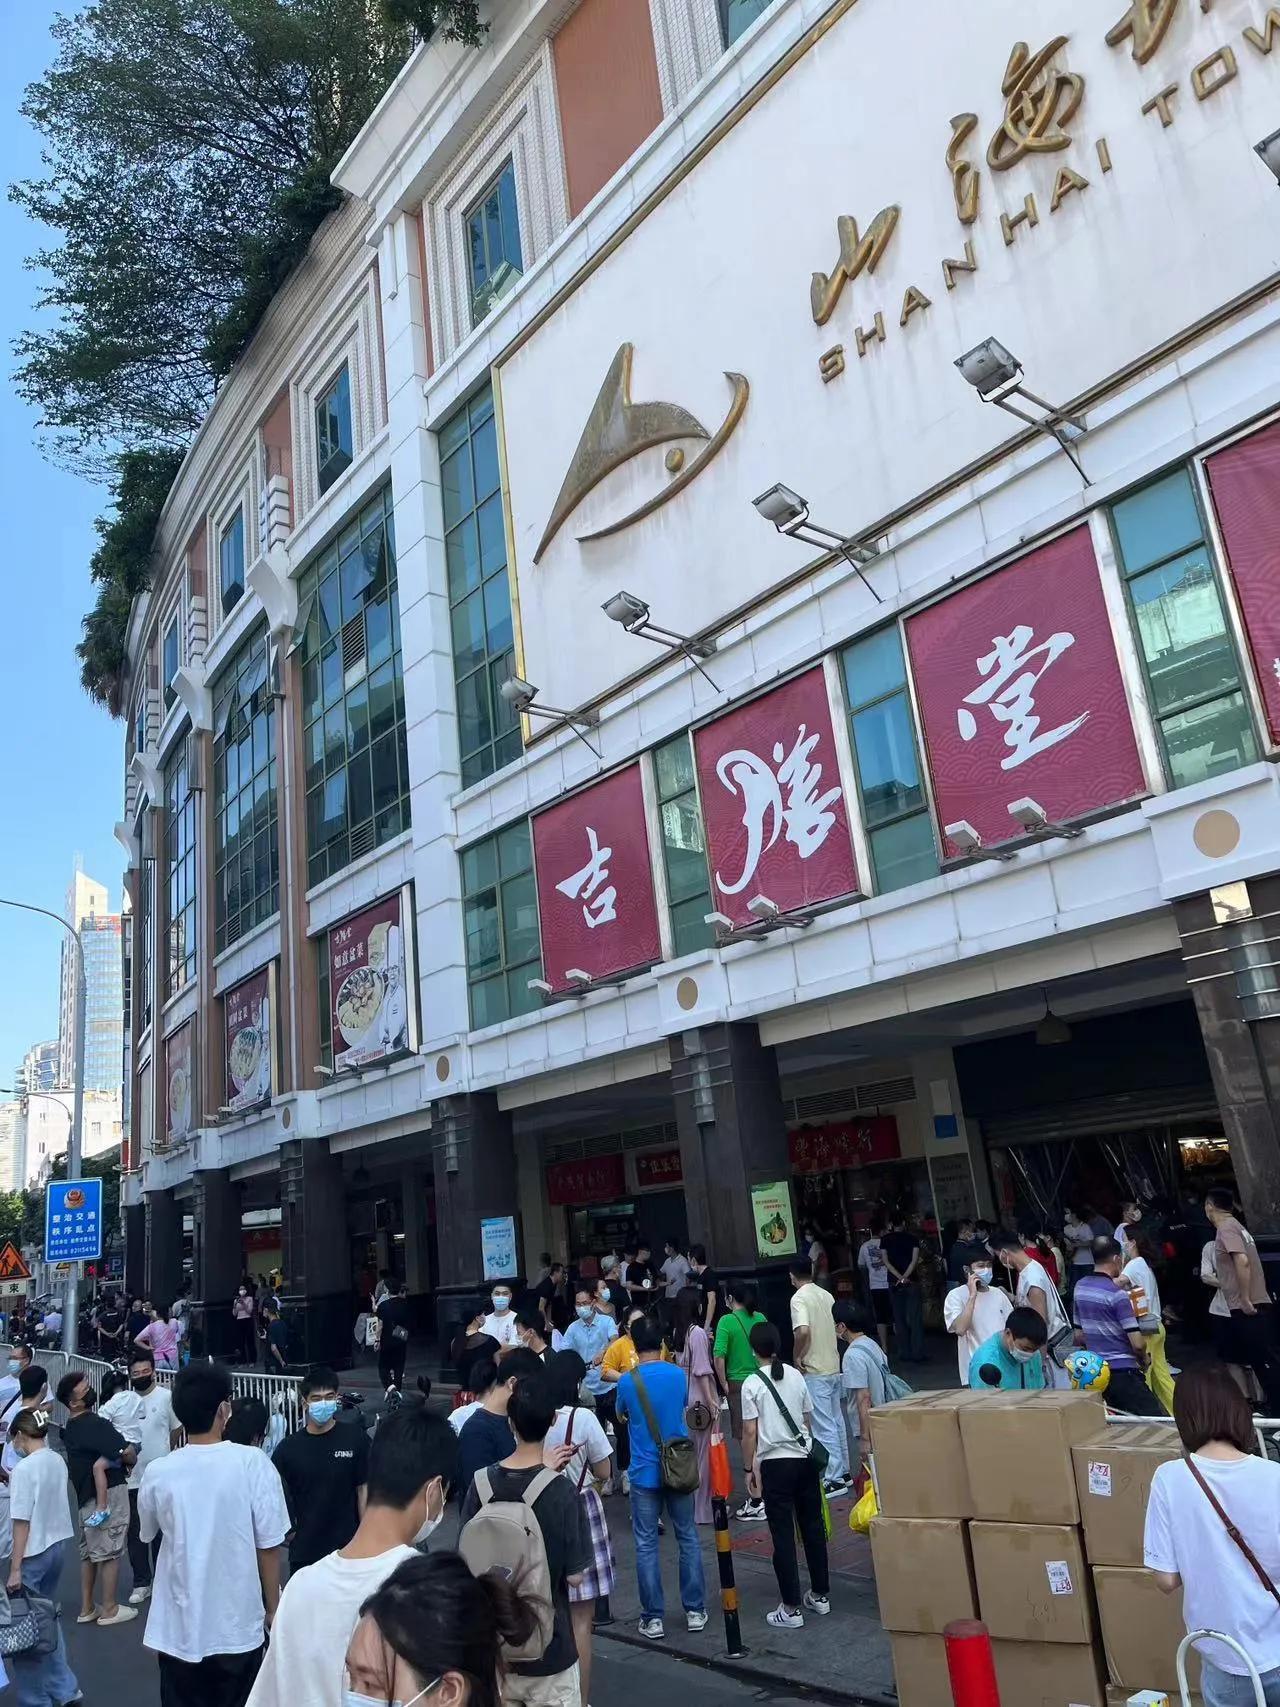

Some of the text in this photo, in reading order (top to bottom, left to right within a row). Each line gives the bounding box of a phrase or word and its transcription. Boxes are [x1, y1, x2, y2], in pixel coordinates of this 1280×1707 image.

[818, 137, 1113, 383] SHANHAI
[52, 1211, 96, 1223] 整治交通
[51, 1224, 96, 1236] 秩序乱点
[112, 1258, 121, 1271] P
[0, 1283, 20, 1295] 束
